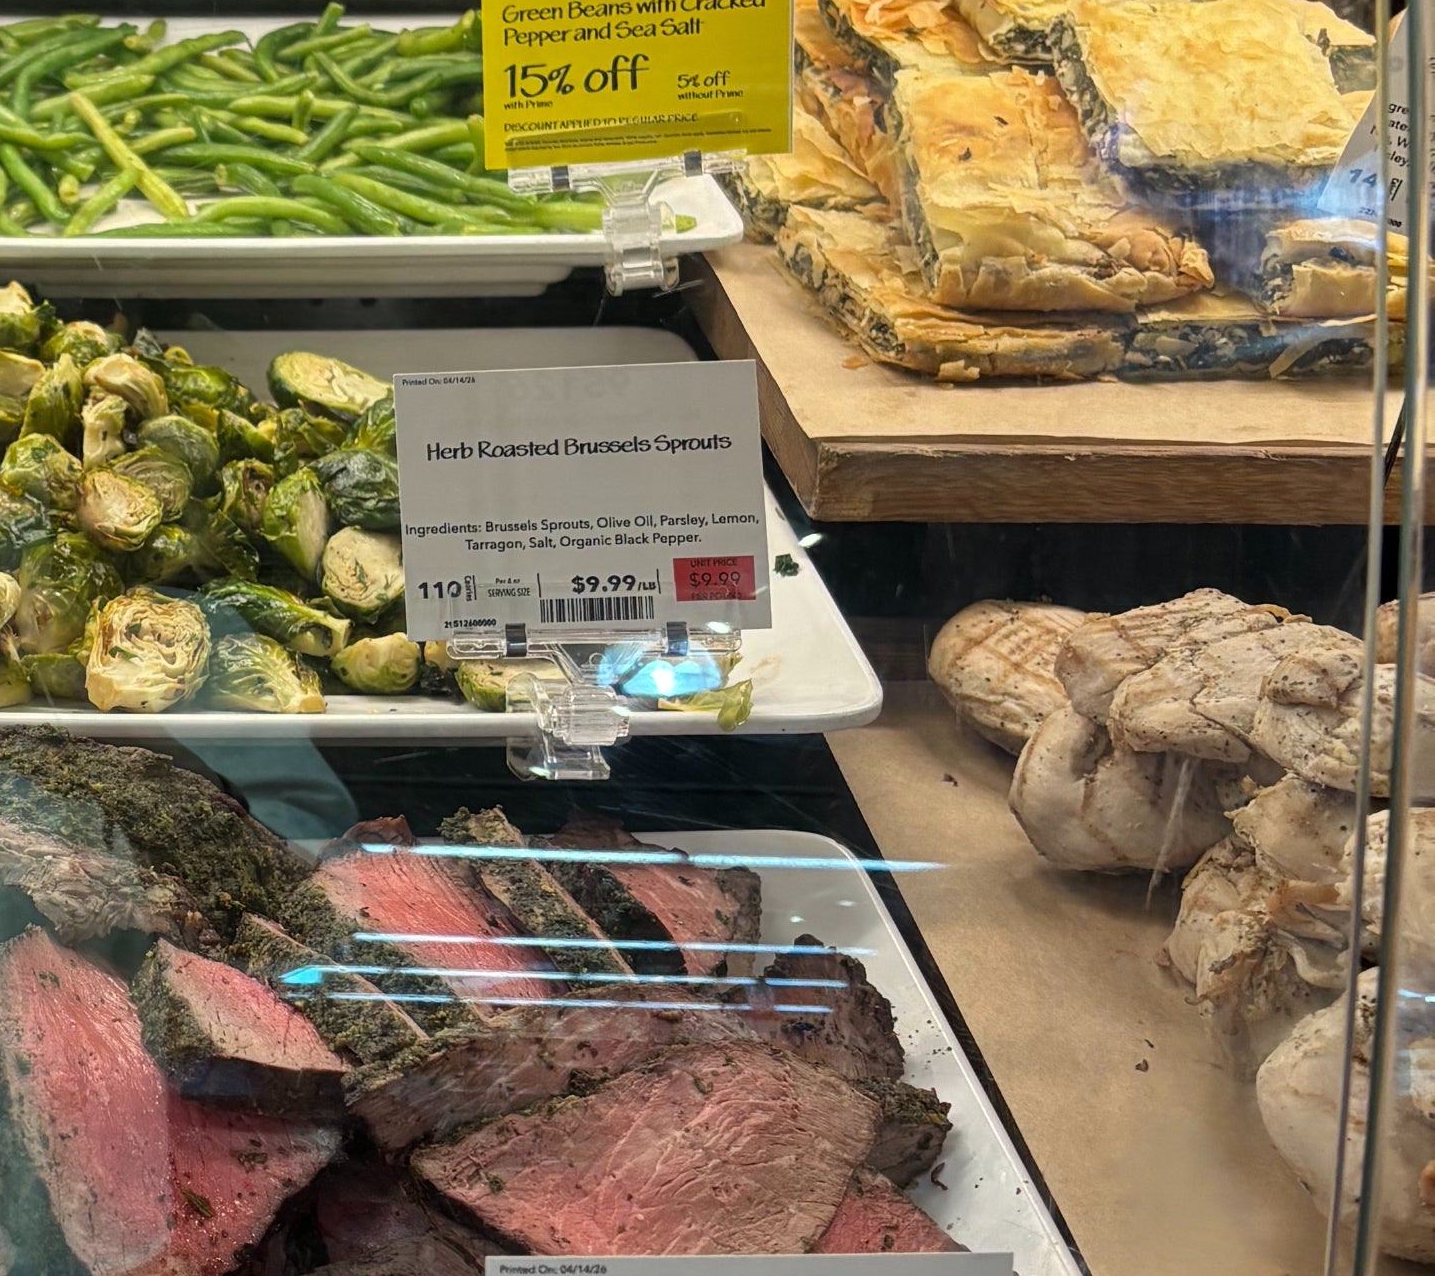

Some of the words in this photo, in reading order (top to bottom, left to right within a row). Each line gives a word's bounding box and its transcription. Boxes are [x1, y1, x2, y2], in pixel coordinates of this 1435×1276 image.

[501, 4, 564, 24] Green
[567, 0, 633, 20] Beans
[503, 27, 572, 47] Pepper
[573, 21, 612, 42] and
[614, 20, 657, 40] Sea
[660, 17, 705, 37] Salt
[503, 63, 575, 98] 15%
[583, 53, 650, 94] off
[677, 74, 701, 89] 5%
[703, 70, 731, 87] off
[503, 100, 524, 110] with
[525, 99, 554, 109] Prime
[677, 91, 714, 101] without
[715, 89, 744, 99] Prime
[503, 121, 558, 133] DISCOUNT
[426, 441, 474, 461] Herb
[477, 439, 559, 459] Roasted
[564, 436, 652, 456] Brussels
[653, 434, 732, 454] Sprouts
[405, 522, 482, 538] Ingredients:
[485, 520, 538, 533] Brussels
[540, 518, 594, 531] Sprouts,
[596, 516, 631, 529] Olive
[634, 514, 658, 529] Oil,
[660, 513, 709, 527] Parsley,
[711, 512, 760, 525] Lemon,
[465, 537, 526, 552] Tarragon,
[528, 536, 557, 549] Salt,
[559, 534, 612, 550] Organic
[614, 532, 650, 545] Black
[652, 531, 703, 547] Pepper.
[690, 557, 711, 568] UNIT
[712, 556, 739, 567] PRICE
[418, 579, 462, 600] 110
[570, 574, 656, 595] $9.99/LB
[689, 571, 741, 589] $9.99
[517, 587, 531, 597] SIZE
[499, 1265, 536, 1275] Printed
